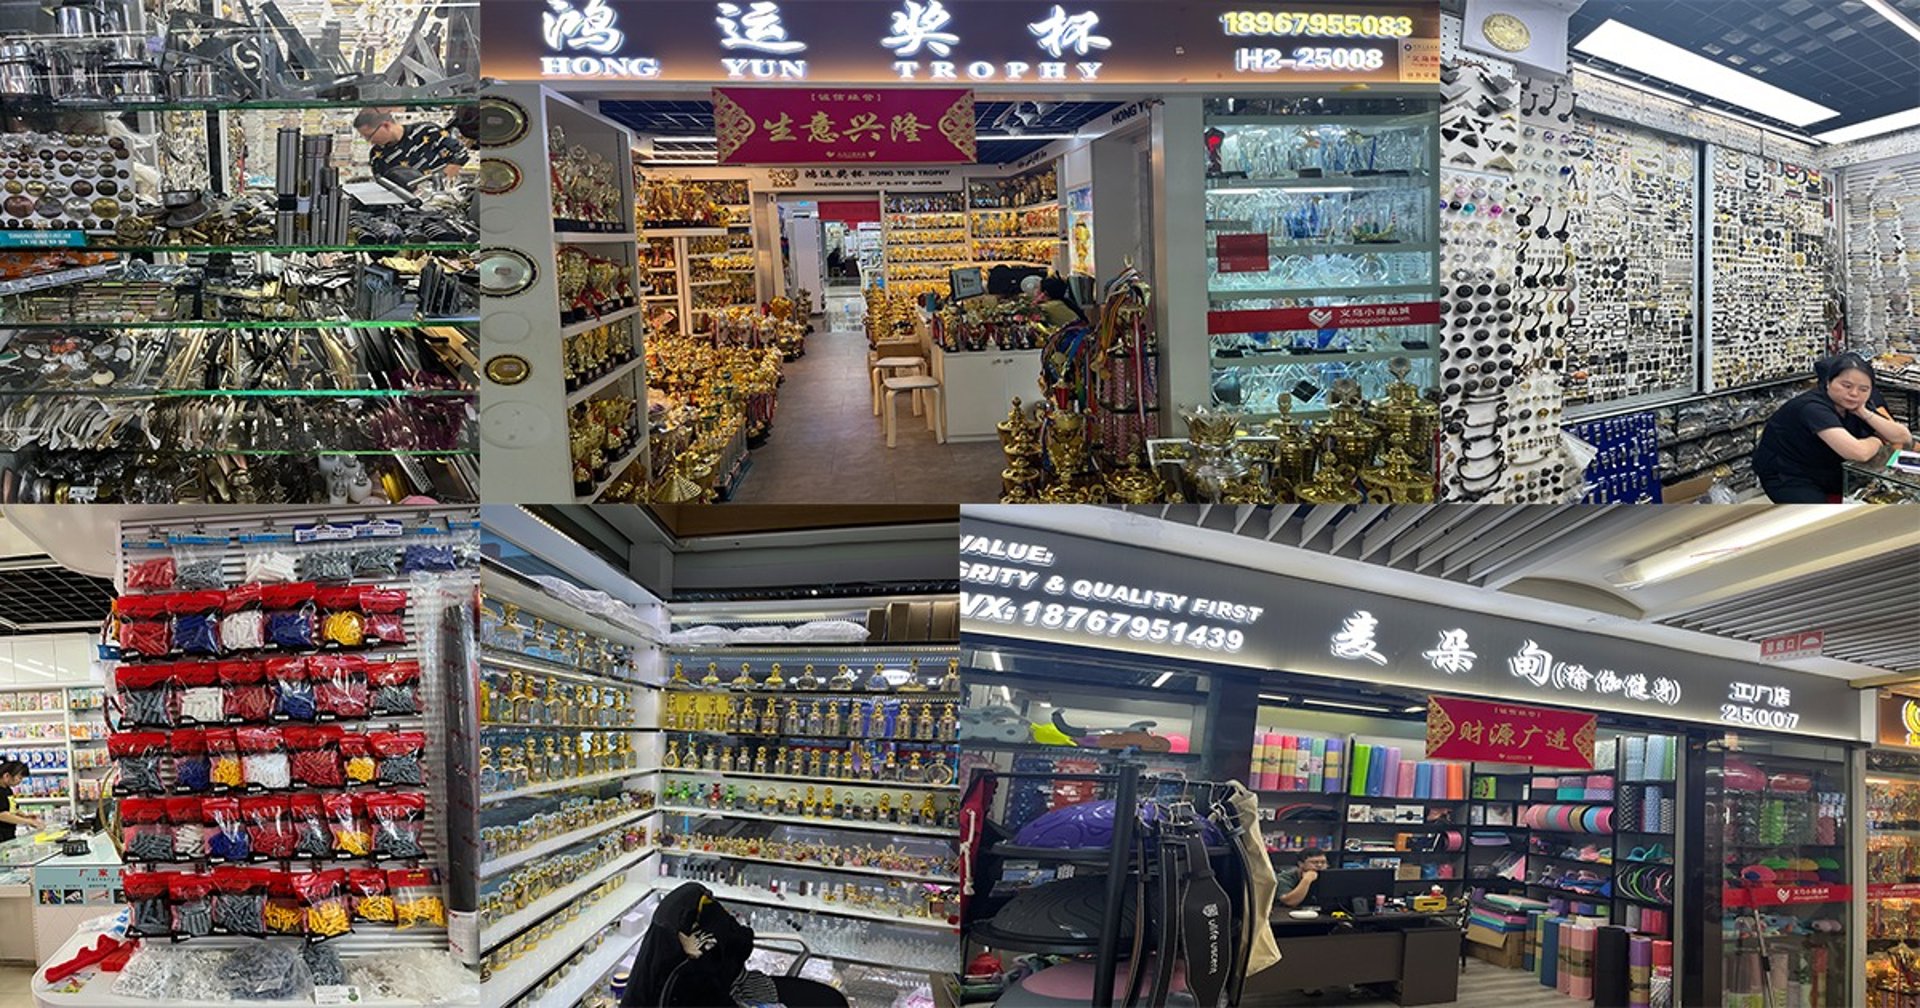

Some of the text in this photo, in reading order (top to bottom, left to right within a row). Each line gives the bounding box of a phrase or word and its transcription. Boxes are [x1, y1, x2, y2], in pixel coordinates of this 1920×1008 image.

[1220, 11, 1413, 37] 18967955083
[540, 57, 1103, 81] HONG YUN TROPHY
[1236, 47, 1384, 71] H2-25008
[762, 111, 932, 143] 生意兴隆
[960, 535, 1054, 565] VALUE:
[1044, 575, 1065, 595] &
[1071, 579, 1189, 611] QUALITY
[1190, 598, 1264, 624] FIRST
[1722, 705, 1800, 729] 25007
[1458, 719, 1570, 750] 财源广进
